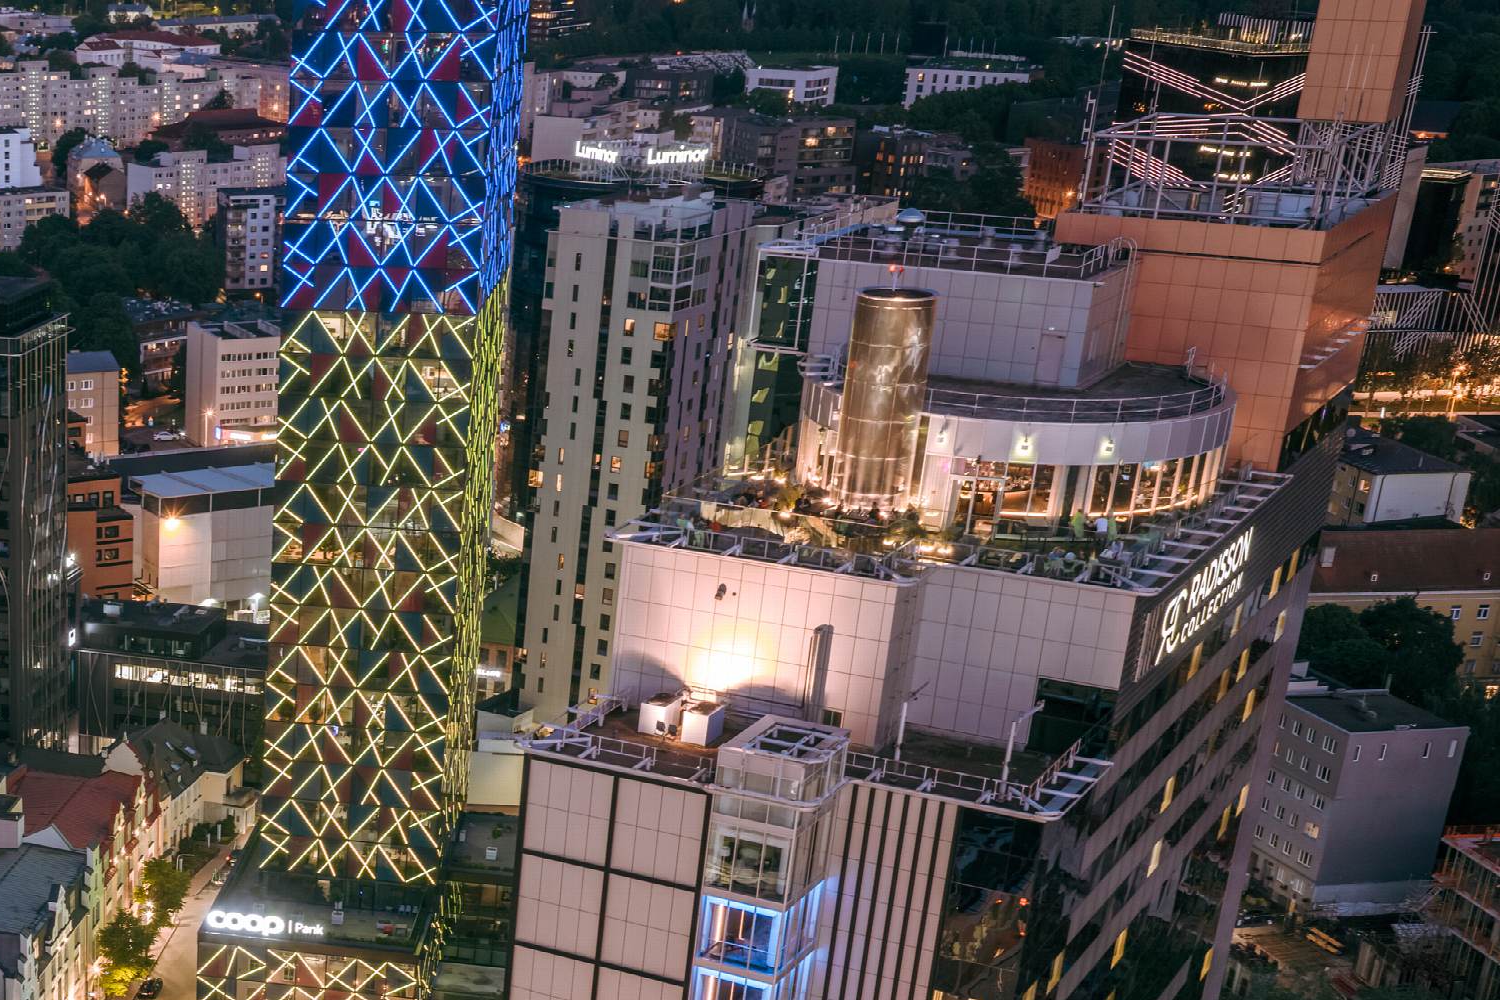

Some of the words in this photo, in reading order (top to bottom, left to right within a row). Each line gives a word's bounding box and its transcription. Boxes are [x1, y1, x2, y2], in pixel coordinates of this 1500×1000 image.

[575, 140, 619, 163] Luminor
[647, 144, 709, 164] Luminor
[1186, 526, 1254, 614] RADISSON
[1180, 571, 1244, 643] COLLECTION
[207, 910, 285, 936] coop
[294, 922, 324, 936] Pank
